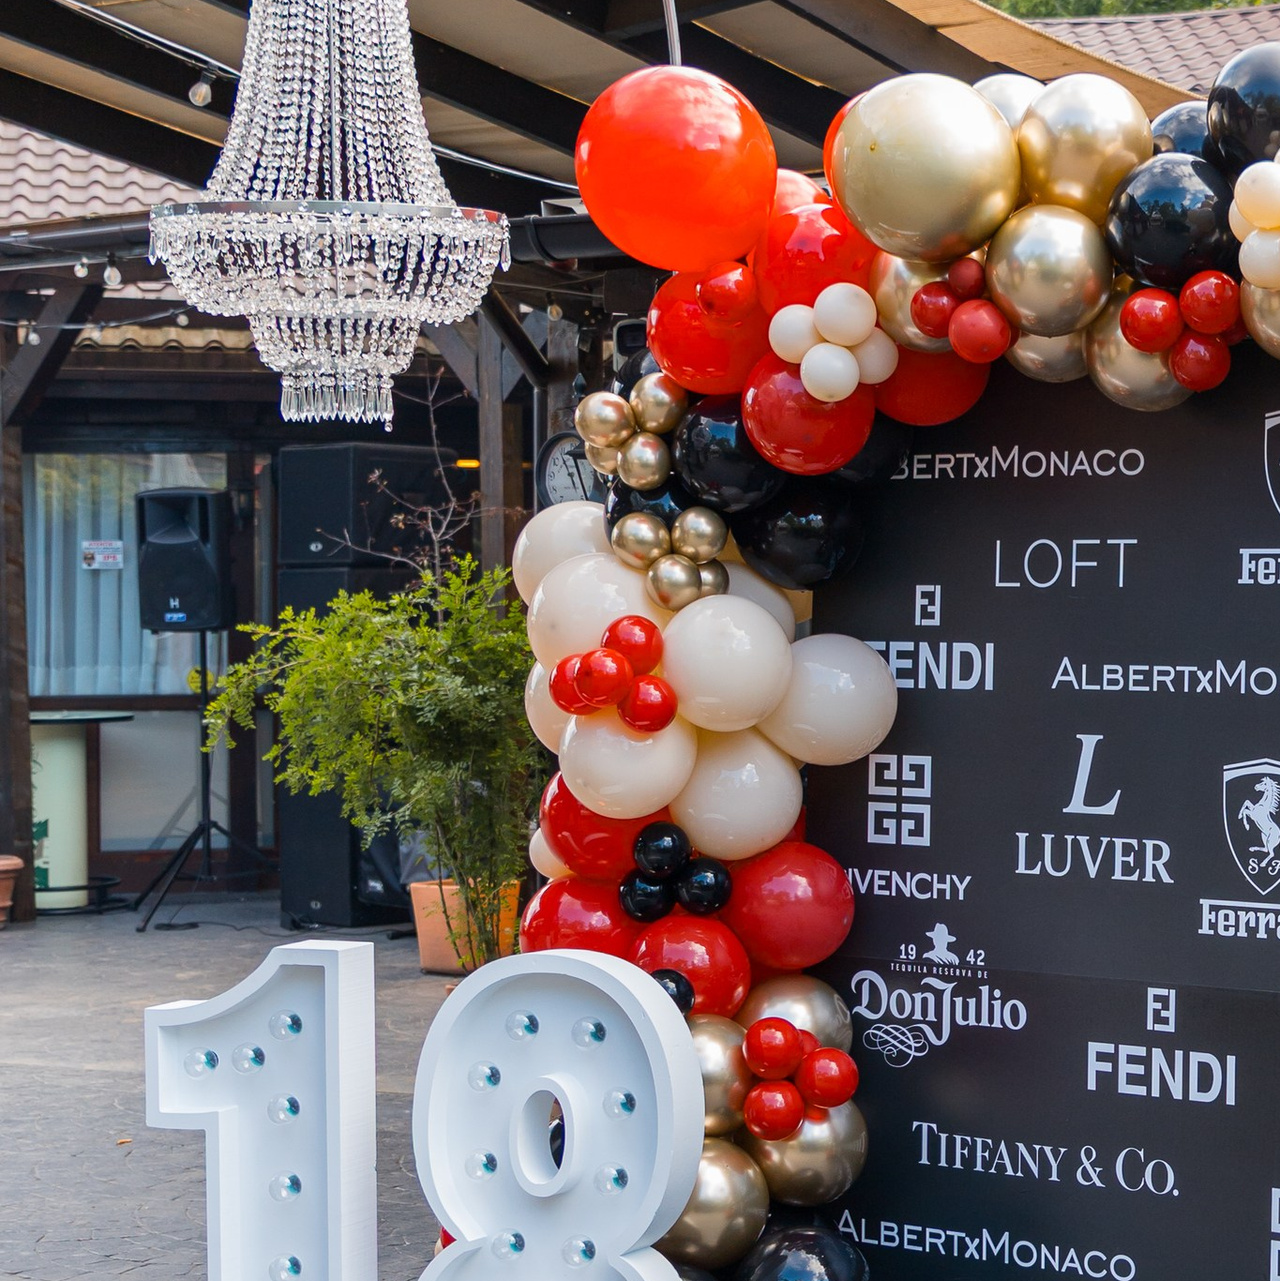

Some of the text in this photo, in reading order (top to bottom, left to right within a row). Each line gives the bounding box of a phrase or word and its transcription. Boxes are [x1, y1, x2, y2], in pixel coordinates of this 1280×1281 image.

[996, 539, 1137, 587] LOFT
[1015, 833, 1174, 883] LUVER
[846, 868, 972, 901] IVENCHY
[890, 962, 988, 979] TEQUILA RESERVA DE
[899, 943, 986, 966] 19 42
[1088, 1042, 1235, 1105] FENDI
[911, 1121, 1068, 1182] TIFFANY
[1076, 1144, 1106, 1188] &
